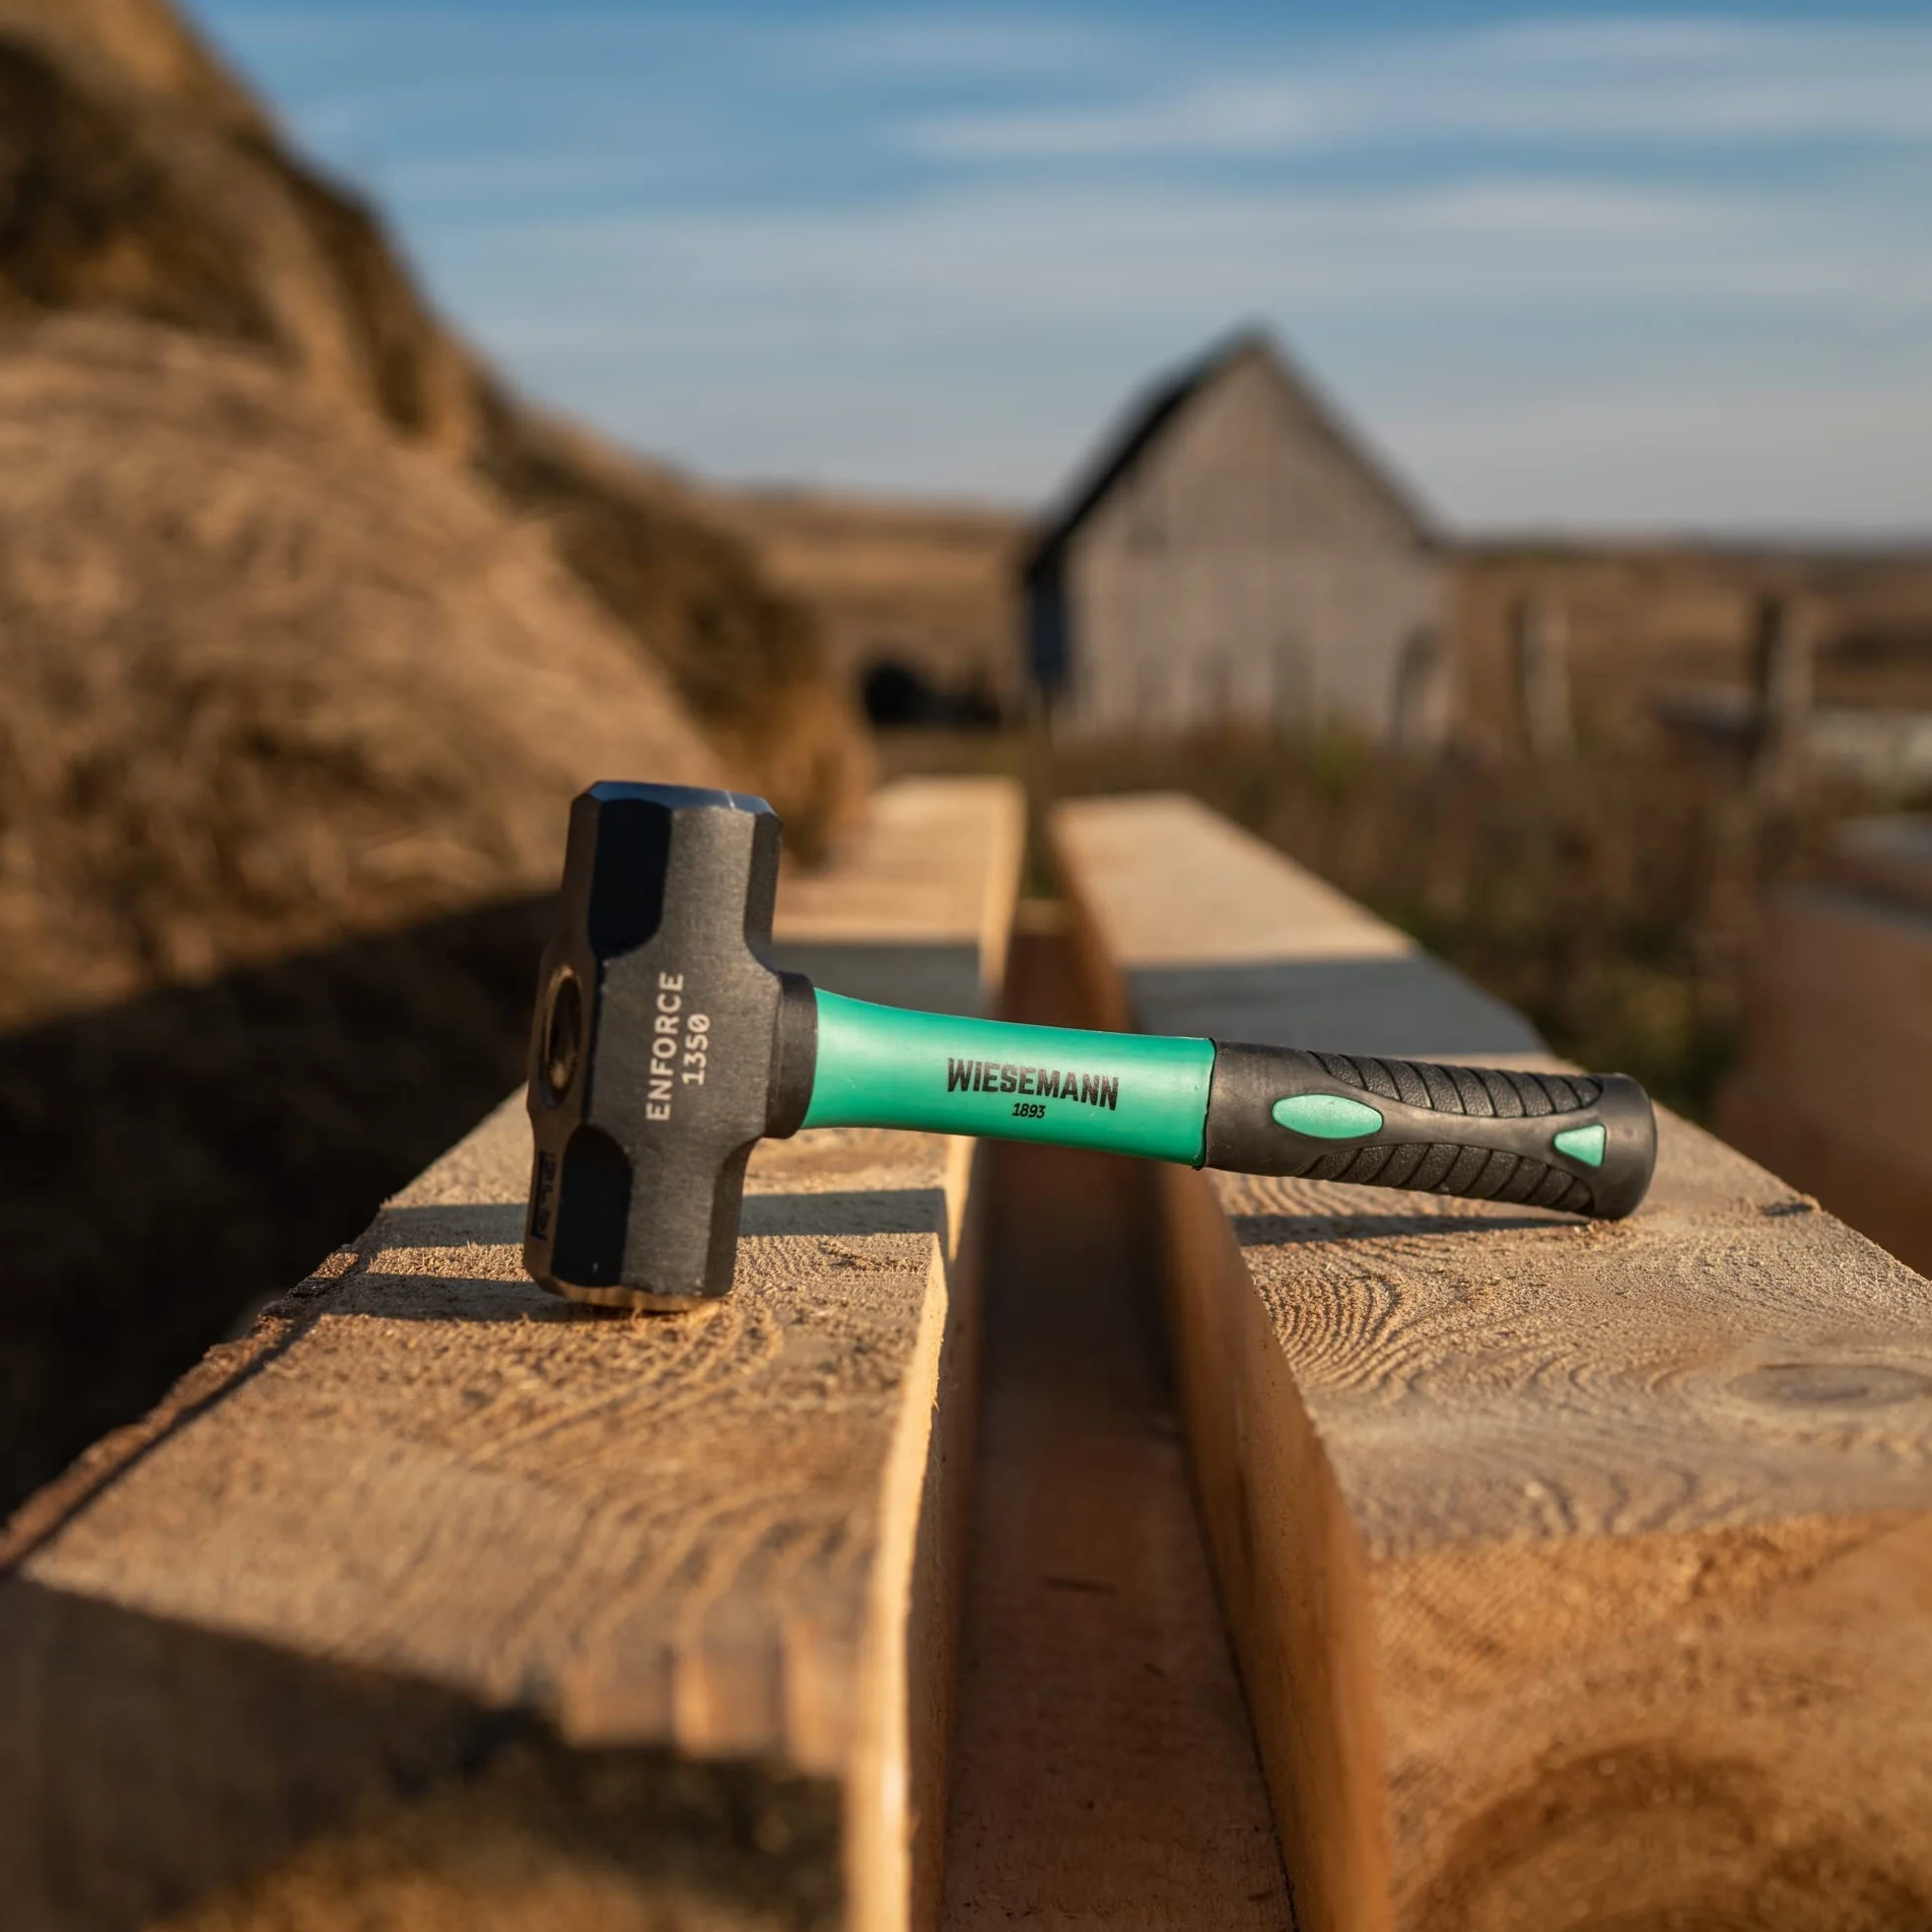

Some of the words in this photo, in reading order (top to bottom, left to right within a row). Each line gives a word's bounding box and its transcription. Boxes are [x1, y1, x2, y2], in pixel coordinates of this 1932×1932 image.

[646, 972, 684, 1121] ENFORCE
[682, 1013, 711, 1086] 1350
[947, 1058, 1120, 1111] WIESEMANN
[1011, 1102, 1047, 1119] 1893
